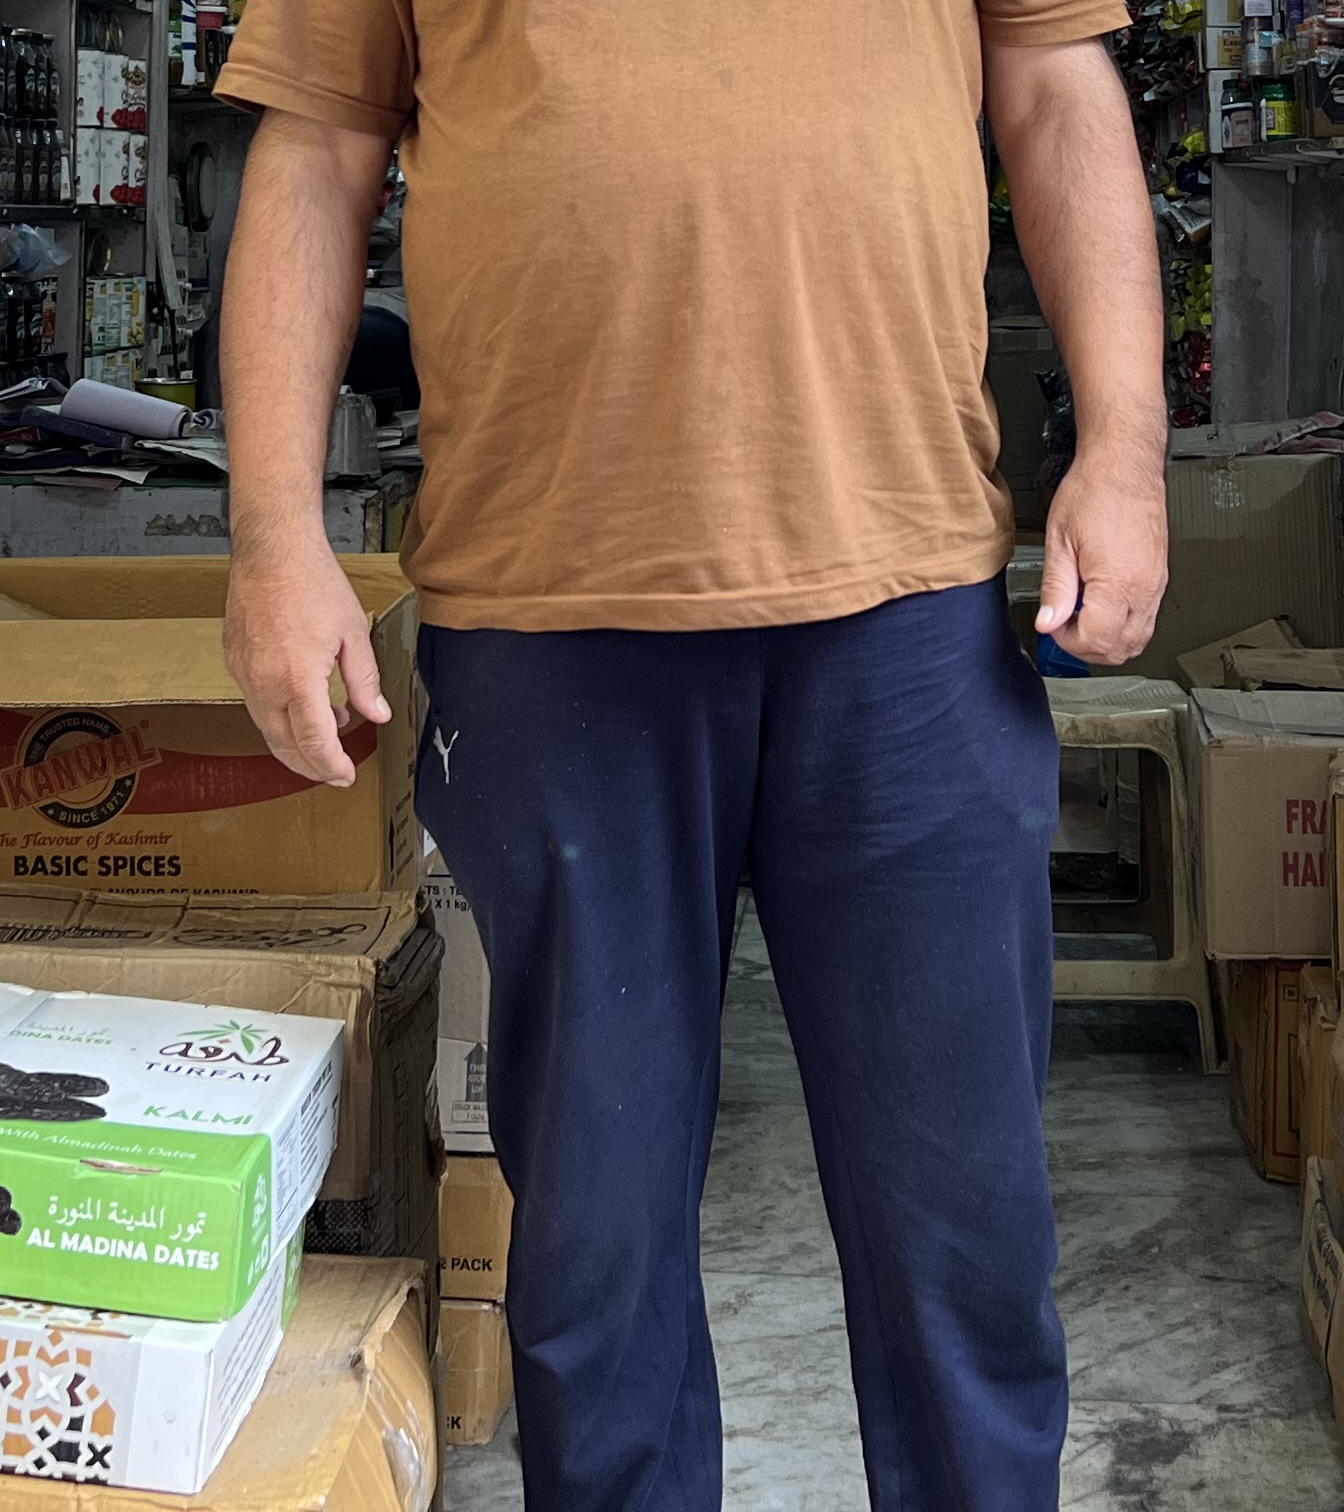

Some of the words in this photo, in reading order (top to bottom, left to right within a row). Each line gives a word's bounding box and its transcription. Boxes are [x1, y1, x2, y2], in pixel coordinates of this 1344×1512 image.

[40, 717, 81, 744] TRUSTED
[82, 718, 111, 734] NAME
[5, 726, 158, 809] KANWAL
[59, 810, 100, 823] SINCE
[101, 791, 125, 815] 1971
[21, 831, 80, 849] Flavour
[86, 831, 99, 850] of
[104, 830, 172, 847] Kashmir
[14, 855, 88, 877] BASIC
[97, 855, 181, 877] SPICES
[146, 1061, 272, 1083] TURFAH
[142, 1104, 254, 1126] KALMI
[0, 1126, 40, 1142] With
[47, 1196, 101, 1227] المنورة
[109, 1201, 165, 1230] المدينة
[26, 1227, 55, 1249] AL
[60, 1232, 148, 1262] MADINA
[153, 1245, 220, 1270] DATES
[451, 1257, 493, 1272] PACK
